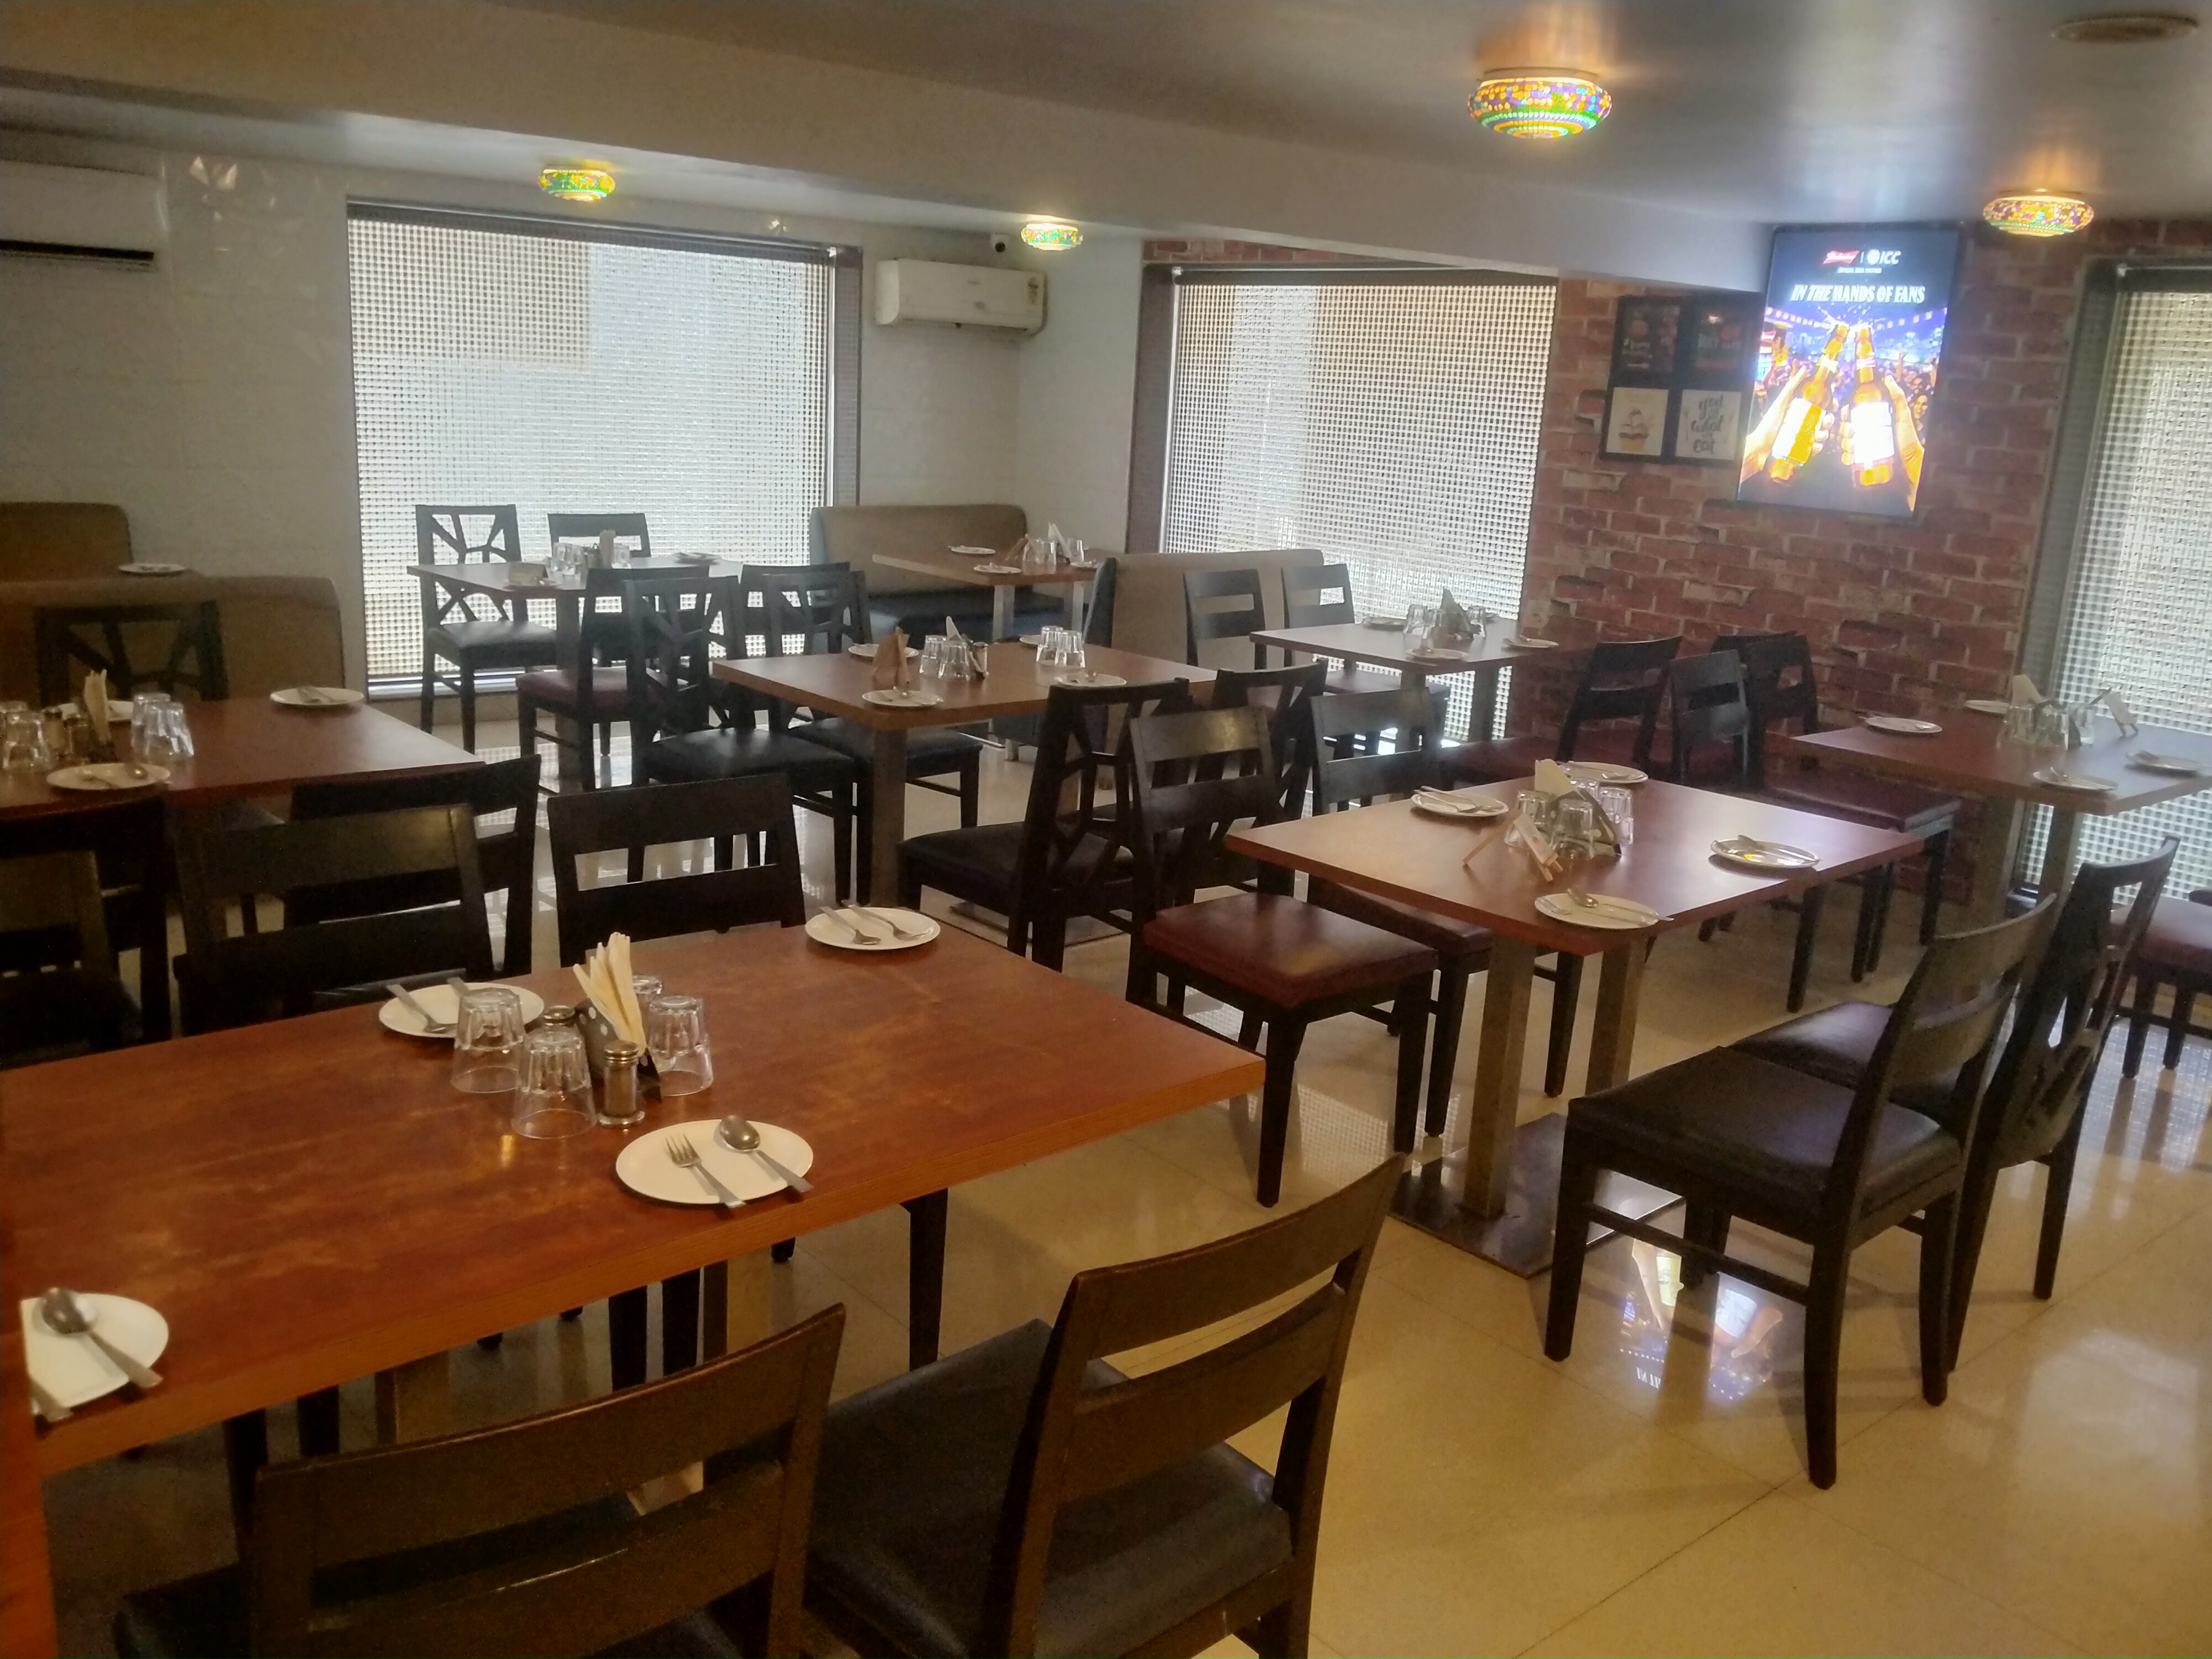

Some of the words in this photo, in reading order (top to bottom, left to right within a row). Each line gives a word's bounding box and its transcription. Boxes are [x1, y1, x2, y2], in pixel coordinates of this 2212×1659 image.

[1879, 250, 1902, 265] ICC
[1790, 284, 1808, 301] IN
[1806, 284, 1833, 302] THE
[1832, 285, 1875, 302] HANDS
[1877, 285, 1894, 303] OF
[1894, 285, 1926, 304] FANS
